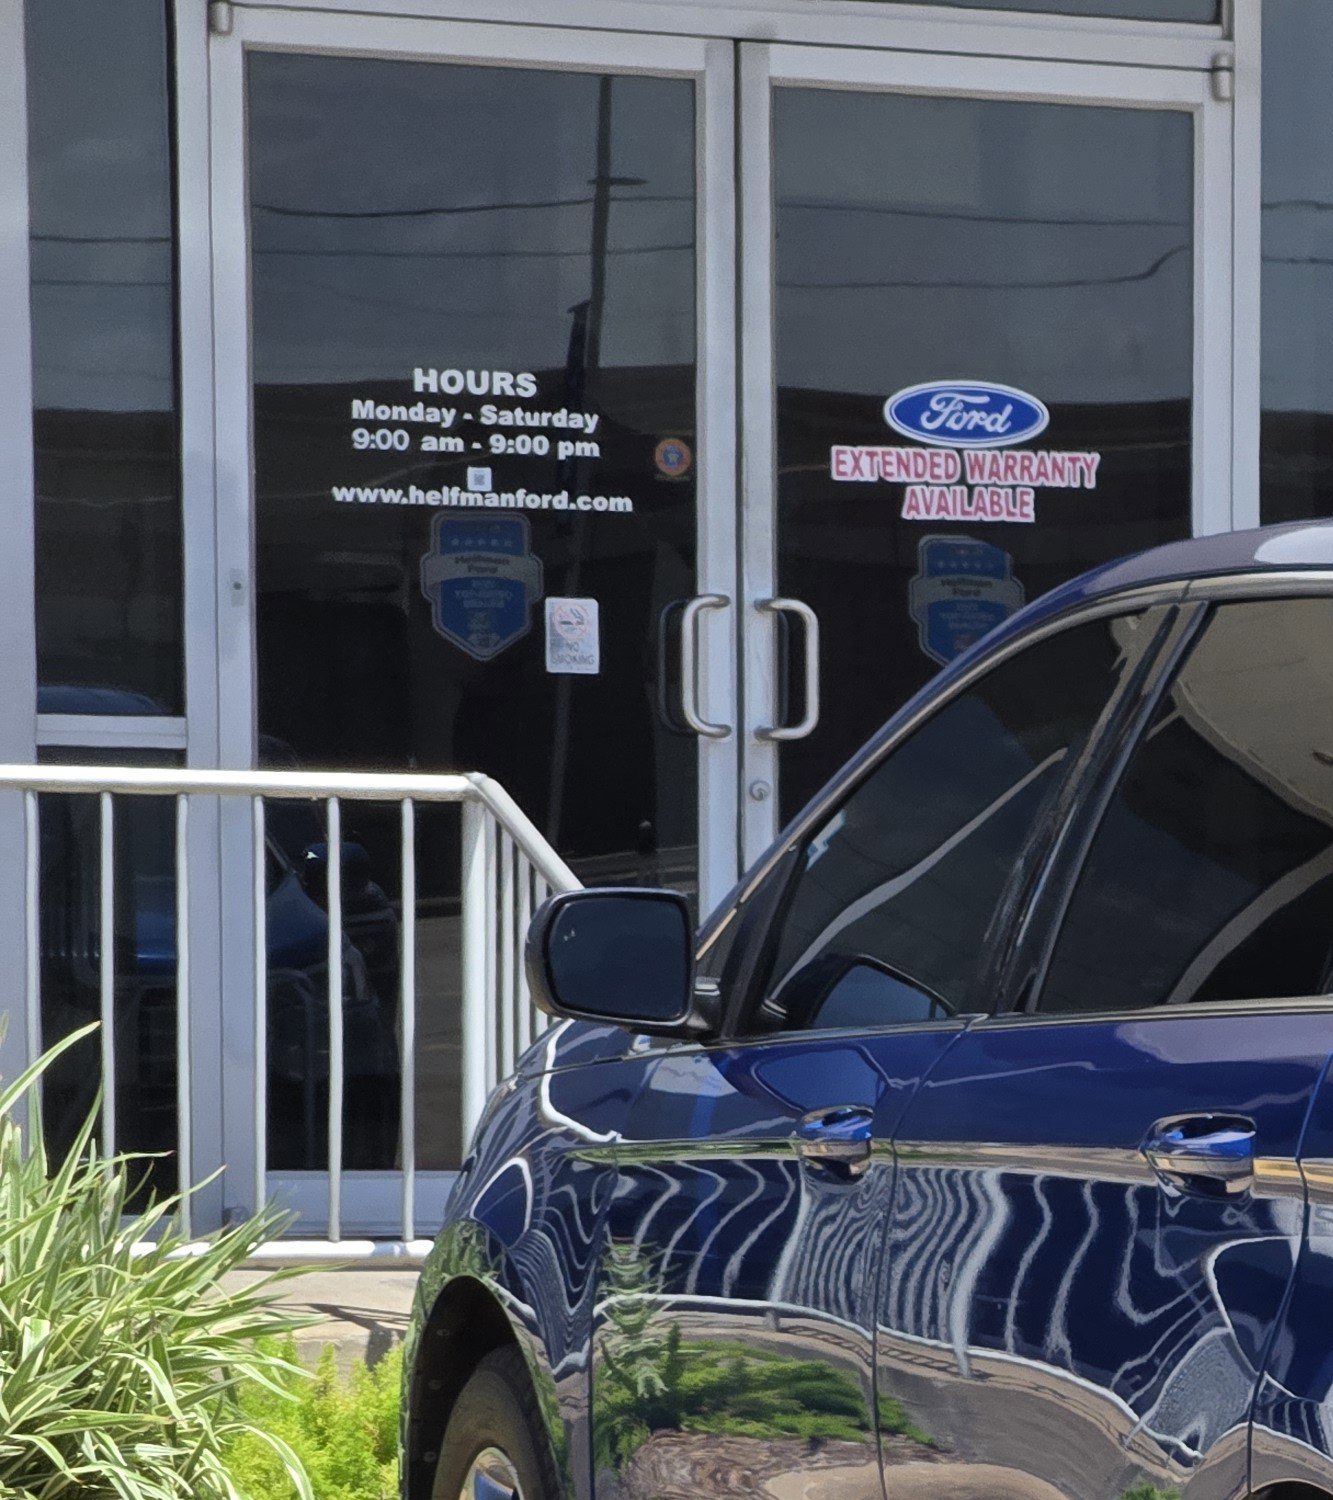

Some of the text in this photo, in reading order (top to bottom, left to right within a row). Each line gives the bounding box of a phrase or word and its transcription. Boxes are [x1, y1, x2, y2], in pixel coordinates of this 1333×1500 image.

[412, 367, 538, 398] HOURS
[351, 399, 457, 428] Monday
[479, 404, 600, 433] Saturday
[920, 392, 1013, 433] Ford
[351, 428, 410, 451] 9:00
[420, 435, 464, 453] am
[489, 434, 549, 455] 9:00
[557, 440, 600, 460] pm
[834, 449, 1097, 486] EXTENDED WARRANTY
[331, 485, 633, 513] www.helfmanford.com
[905, 487, 1032, 519] AVAILABLE
